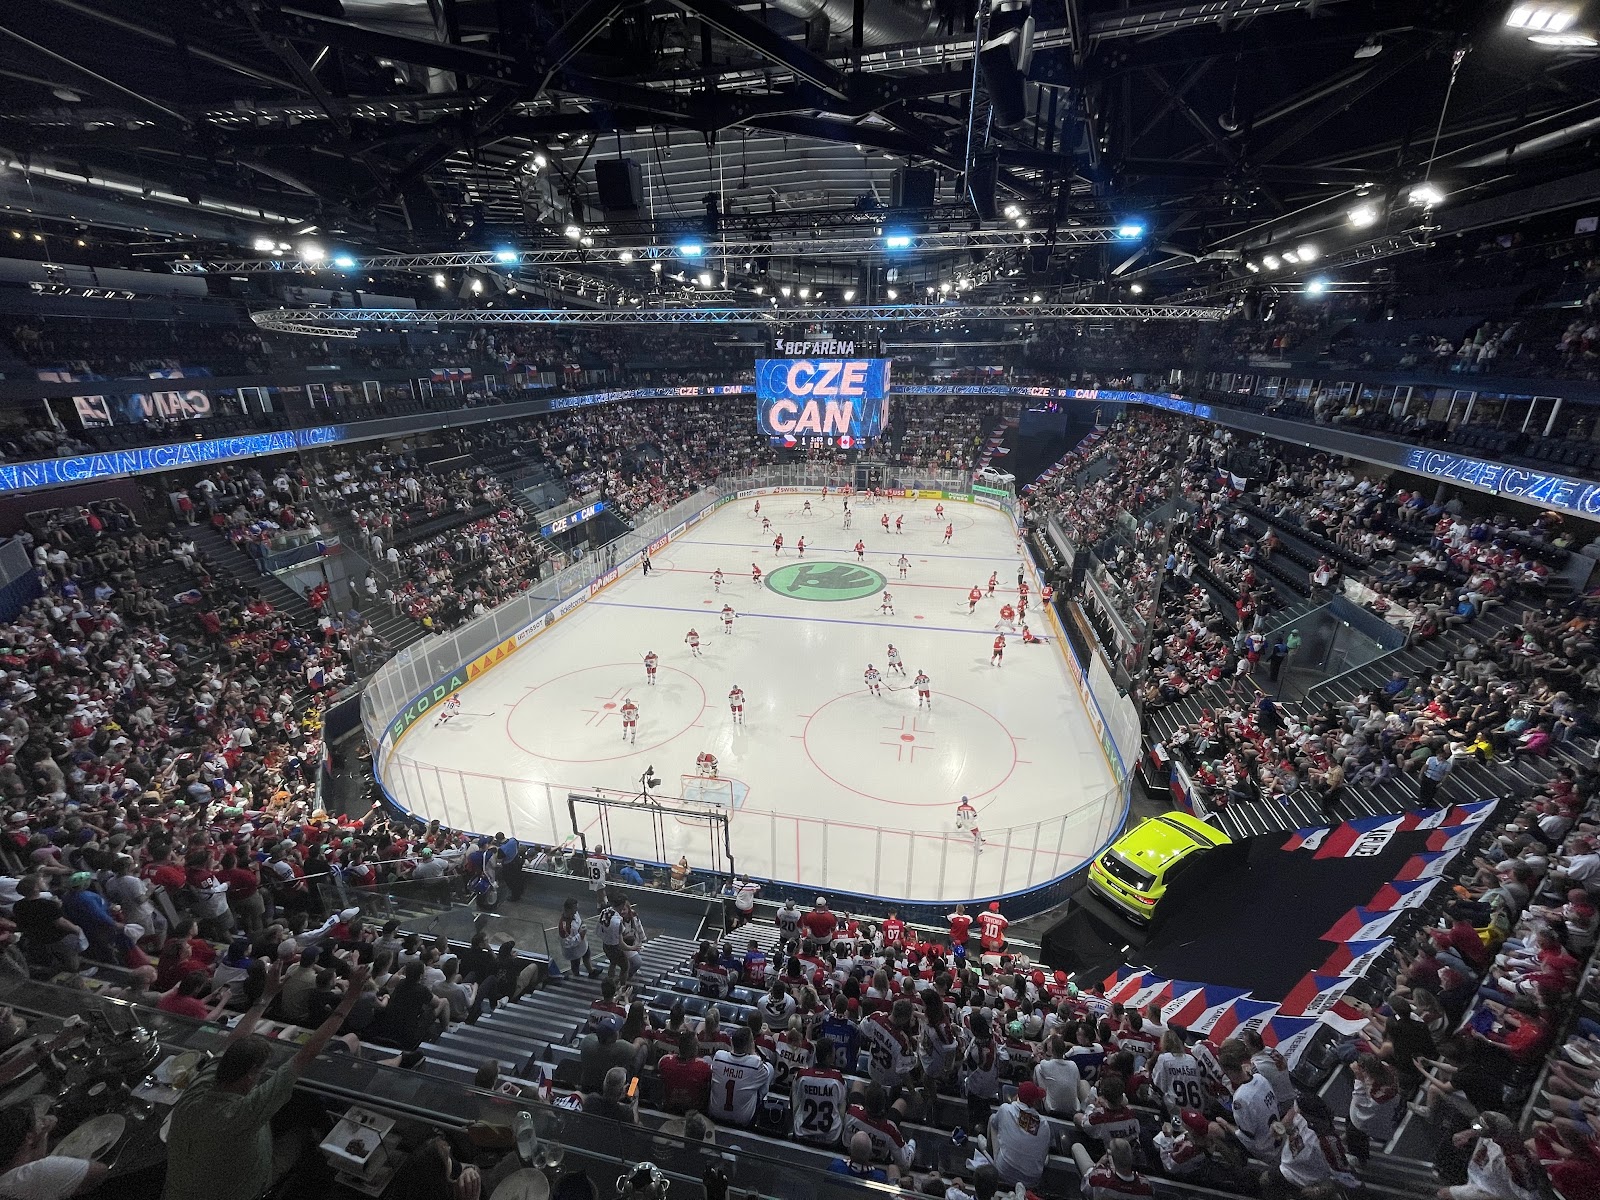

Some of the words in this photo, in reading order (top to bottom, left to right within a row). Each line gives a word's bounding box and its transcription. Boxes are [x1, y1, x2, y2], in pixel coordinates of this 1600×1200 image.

[785, 341, 811, 355] BCF
[811, 341, 855, 355] ARENA
[786, 361, 869, 396] CZE
[679, 386, 699, 396] CZE
[723, 385, 742, 395] CAN
[1030, 387, 1050, 397] CZE
[1075, 389, 1099, 400] CAN
[769, 399, 853, 433] CAN
[552, 517, 568, 532] CZE
[581, 504, 595, 520] CAN
[525, 619, 544, 636] TISSOT
[781, 920, 796, 933] 20
[985, 922, 999, 939] 10
[723, 1066, 744, 1079] MAJO
[723, 1079, 736, 1112] 1
[804, 1083, 834, 1097] SEDLÁK
[1172, 1080, 1201, 1109] 96
[802, 1098, 834, 1133] 23
